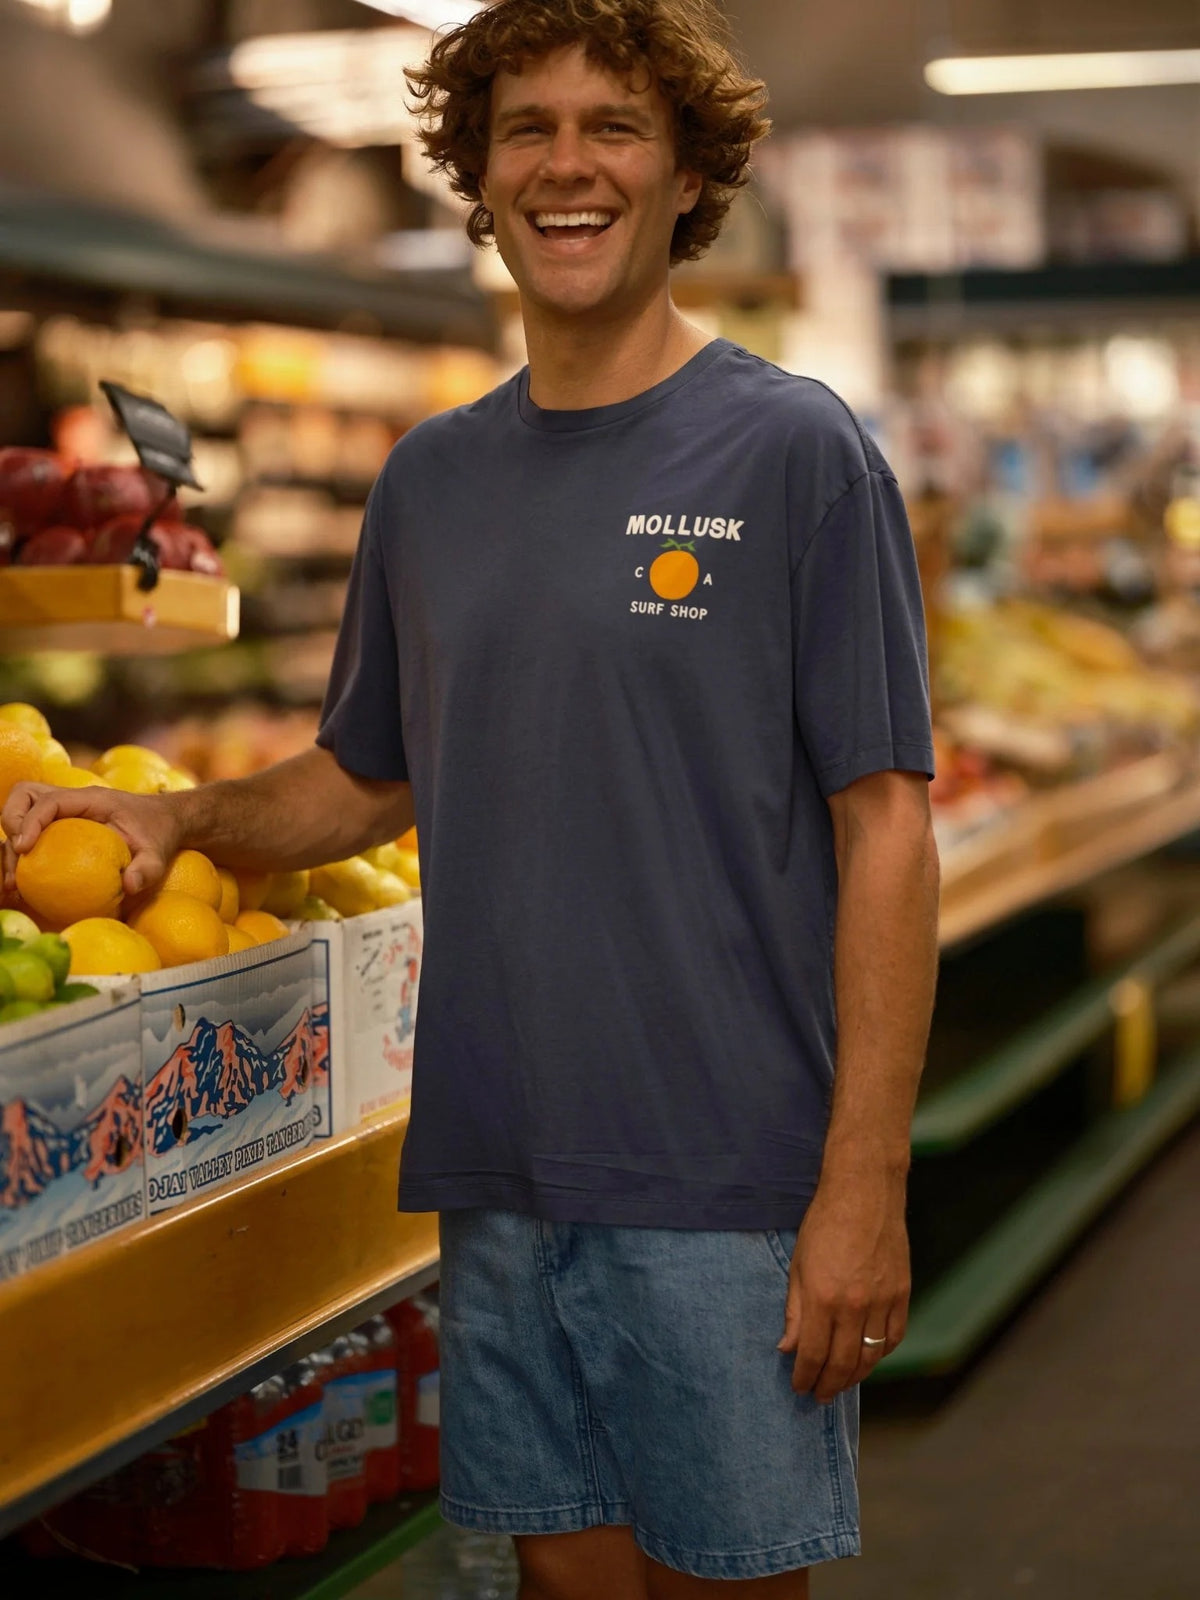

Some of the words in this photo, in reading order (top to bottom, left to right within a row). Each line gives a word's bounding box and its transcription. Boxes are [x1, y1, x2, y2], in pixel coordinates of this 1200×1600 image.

[626, 514, 744, 541] MOLLUSK
[635, 567, 644, 578] C
[703, 573, 713, 586] A
[630, 601, 665, 615] SURF
[670, 605, 708, 620] SHOP
[149, 1173, 188, 1202] OJAI
[190, 1152, 232, 1188] VALLEY
[235, 1138, 263, 1170] PIXIE
